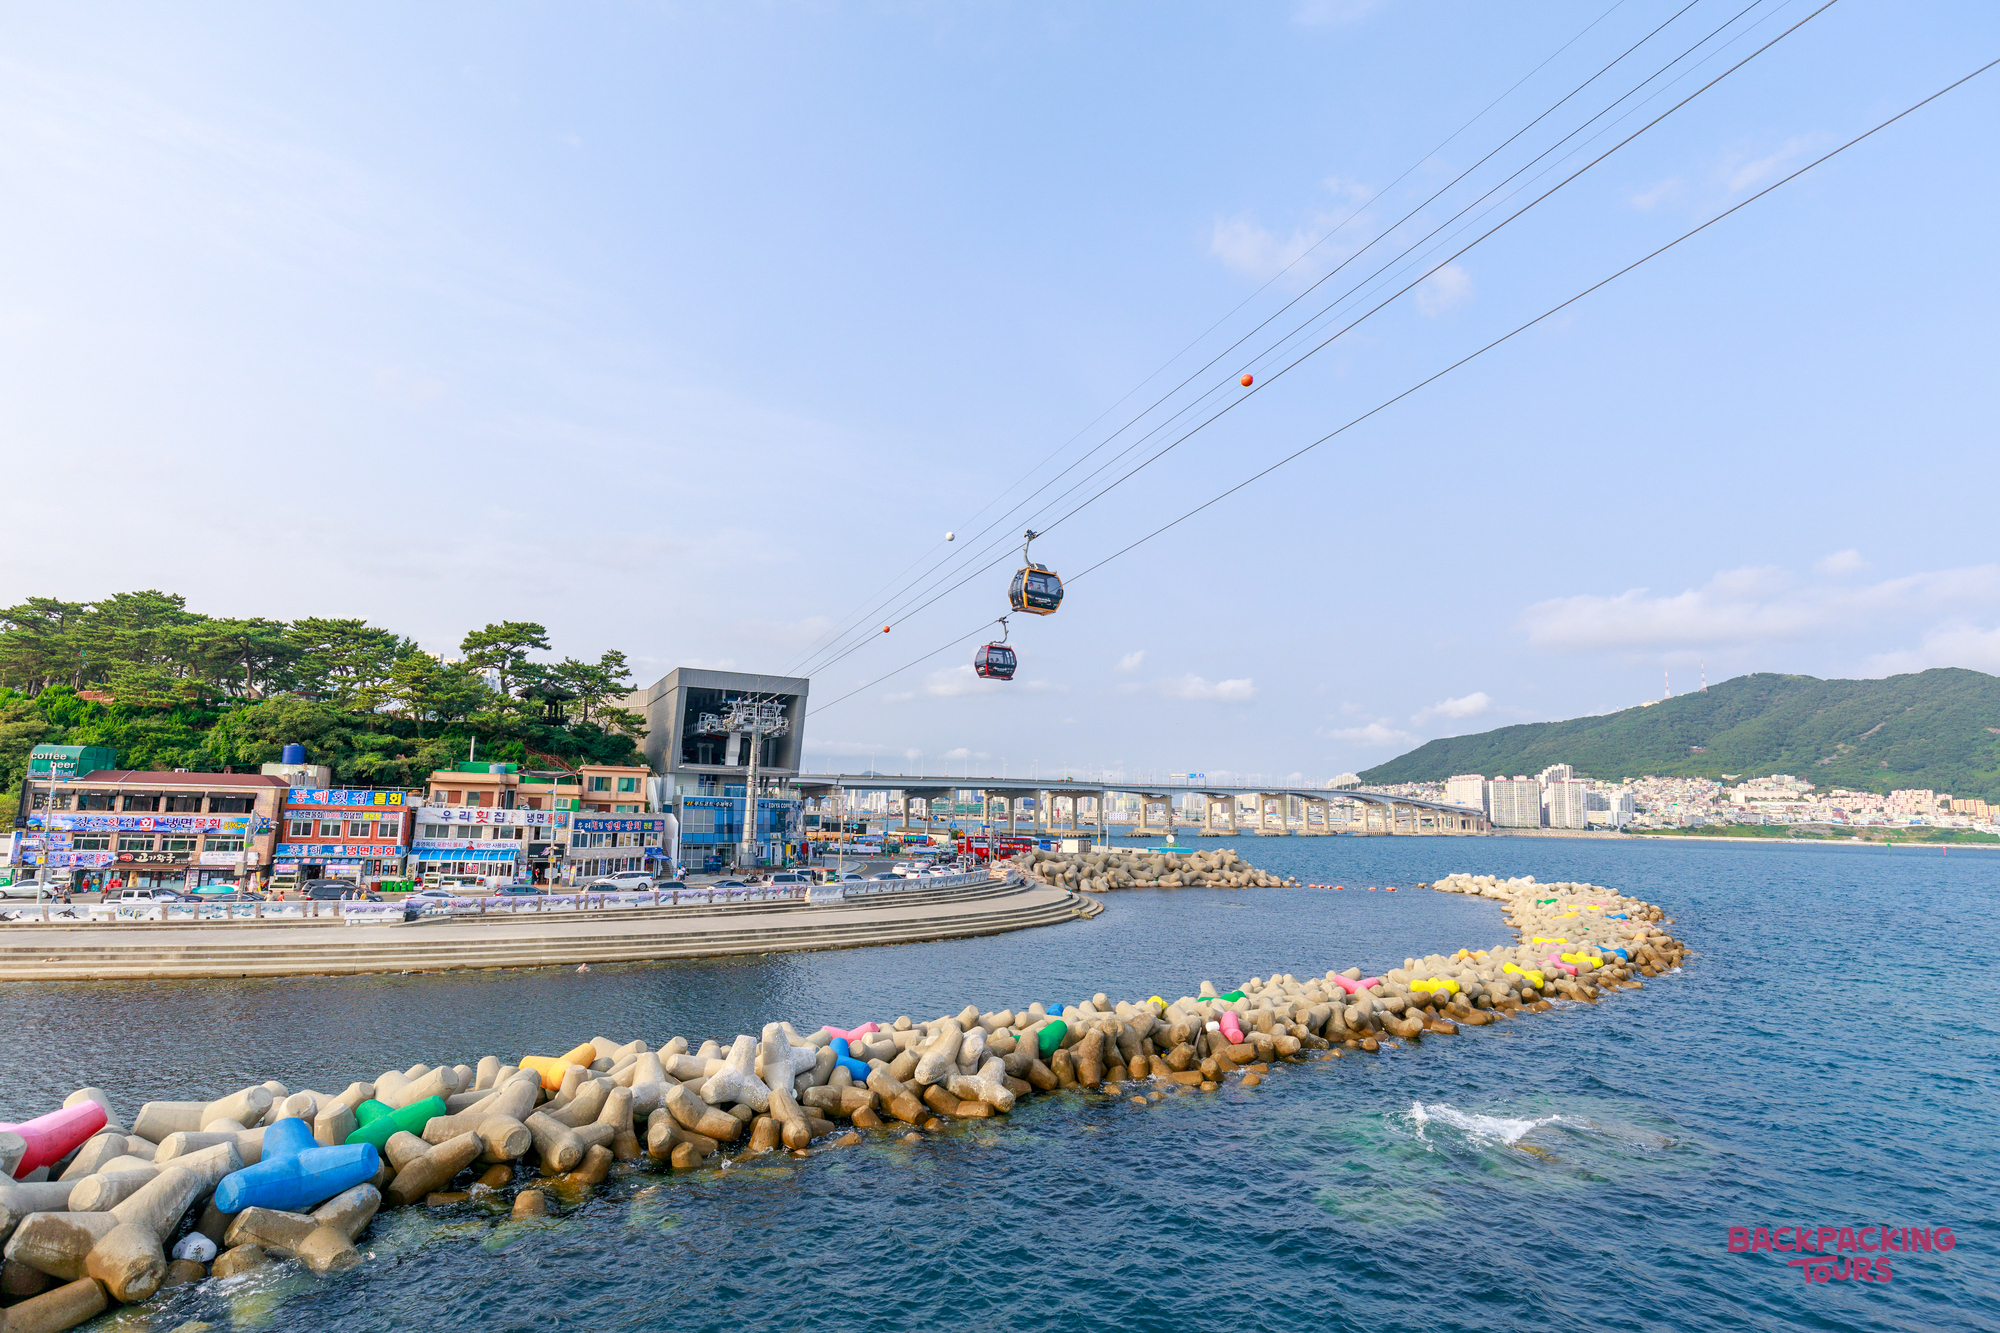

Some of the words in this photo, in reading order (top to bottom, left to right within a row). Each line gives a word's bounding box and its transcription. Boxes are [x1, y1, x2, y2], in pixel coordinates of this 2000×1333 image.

[31, 752, 67, 760] coffee
[50, 761, 75, 769] beer
[292, 790, 368, 805] 동해횟집
[373, 792, 403, 806] 물회
[440, 810, 506, 824] 우리횟집
[139, 818, 156, 831] 회
[166, 818, 221, 829] 냉면물회
[346, 846, 396, 856] 냉면물회
[134, 853, 176, 864] 고기왕국
